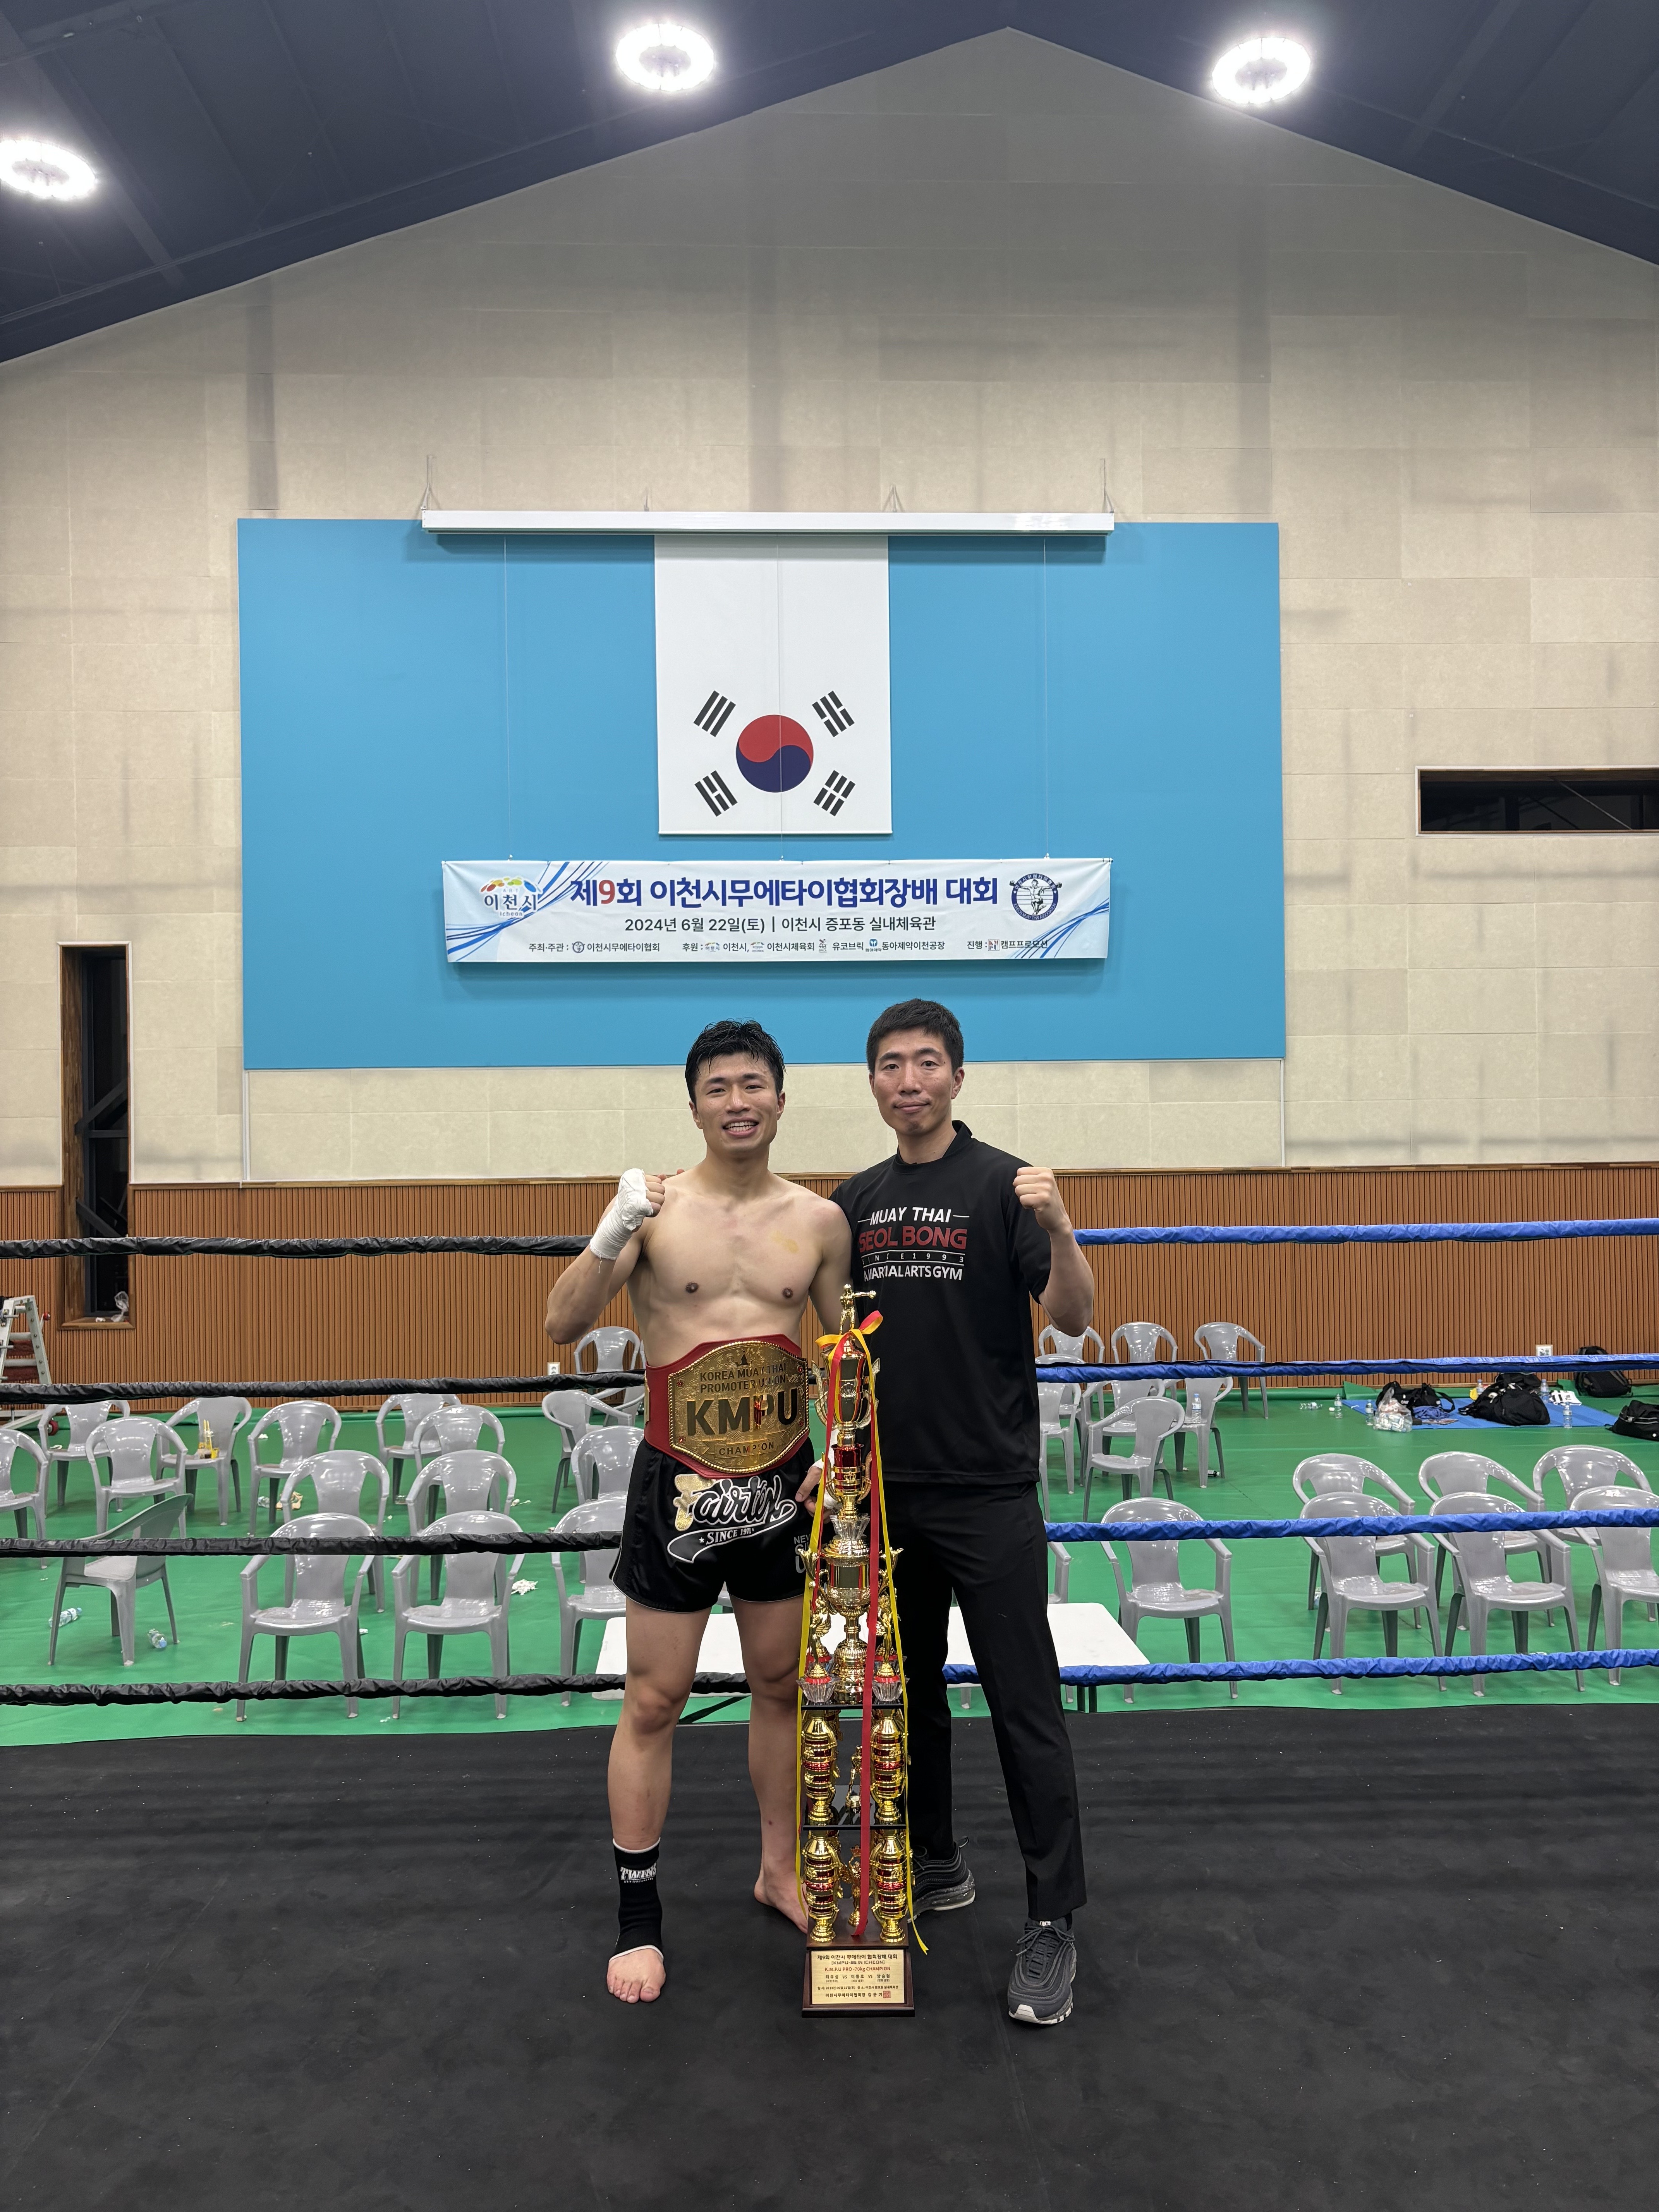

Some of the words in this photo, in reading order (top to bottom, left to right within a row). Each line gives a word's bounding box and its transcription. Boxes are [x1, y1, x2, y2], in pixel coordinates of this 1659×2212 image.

[570, 878, 641, 907] 제9회
[650, 877, 938, 908] 이천시무에타이협회장배
[946, 876, 998, 905] 대회
[484, 894, 536, 911] 이천시
[625, 918, 677, 932] 2024년
[681, 918, 704, 932] 6월
[709, 918, 765, 933] 22일(토)
[781, 917, 821, 931] 이천시
[825, 917, 866, 931] 증포동
[869, 917, 936, 931] 실내체육관
[587, 943, 660, 952] 이천시무에타이협회
[682, 943, 698, 952] 후원
[767, 942, 814, 951] 이천시체육회
[832, 942, 864, 951] 유코브릭
[882, 941, 945, 950] 동아제약이천공장
[967, 941, 982, 949] 진행
[1001, 940, 1048, 949] 캠프프로모션
[870, 1207, 907, 1226] MUAY
[912, 1207, 951, 1223] THAI
[858, 1227, 898, 1253] SEOL
[902, 1226, 967, 1250] BONG
[912, 1253, 964, 1263] 1993
[905, 1265, 932, 1278] ARTS
[933, 1266, 963, 1281] GYM
[700, 1370, 735, 1381] KOREA
[767, 1362, 786, 1374] THAI
[700, 1379, 756, 1393] PROMOTER
[759, 1375, 786, 1387] UNION
[687, 1388, 798, 1436] KMPU
[706, 1529, 738, 1545] SINCE
[793, 1534, 810, 1544] NEV
[795, 1542, 809, 1555] GI
[795, 1556, 806, 1573] U
